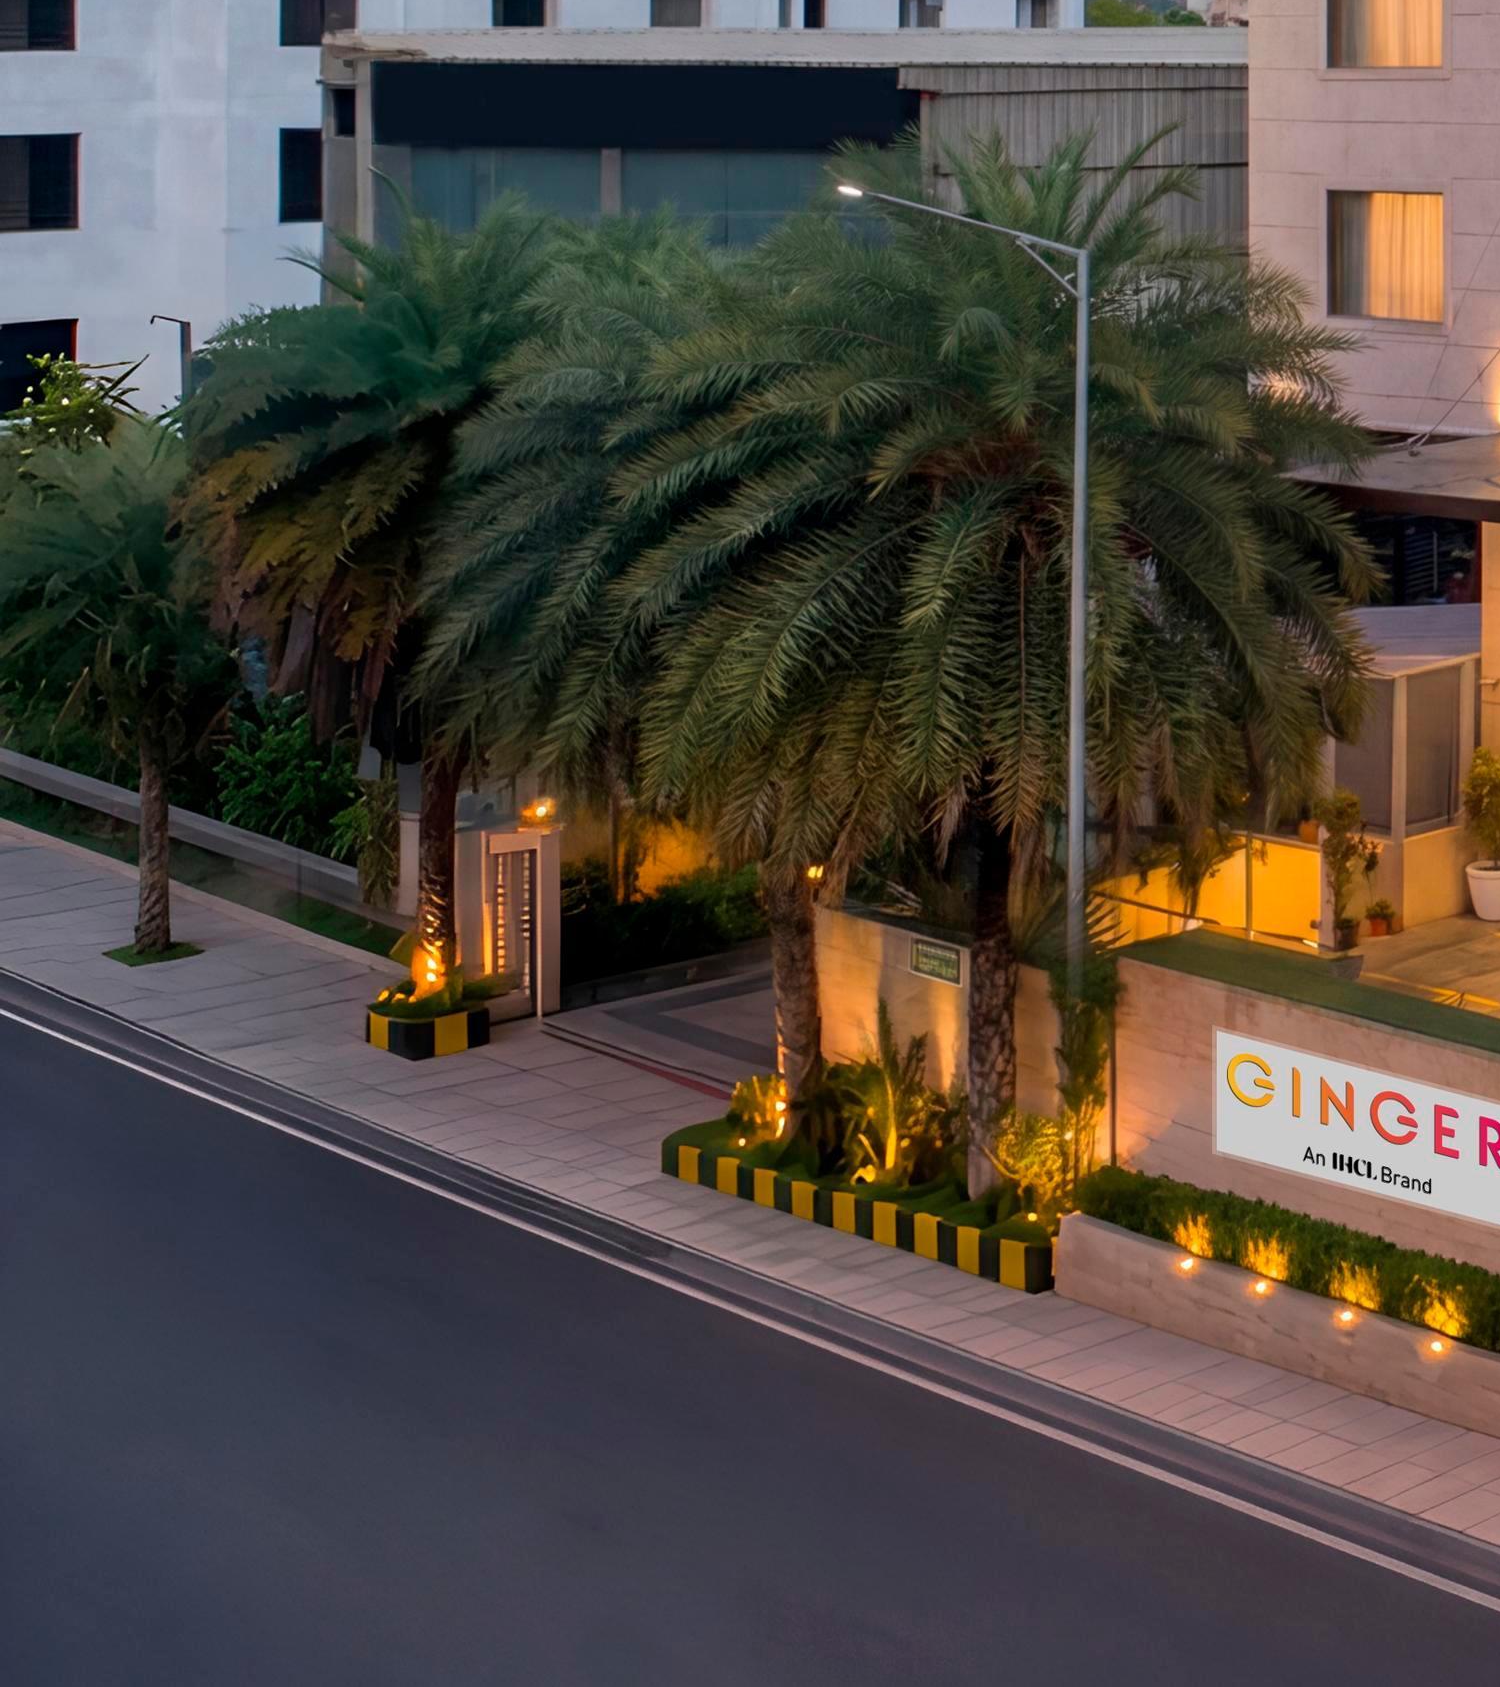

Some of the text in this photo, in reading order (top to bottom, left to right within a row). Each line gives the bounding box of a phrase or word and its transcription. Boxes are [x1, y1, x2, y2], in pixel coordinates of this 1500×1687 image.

[1302, 1146, 1433, 1196] An IHCL Brand
